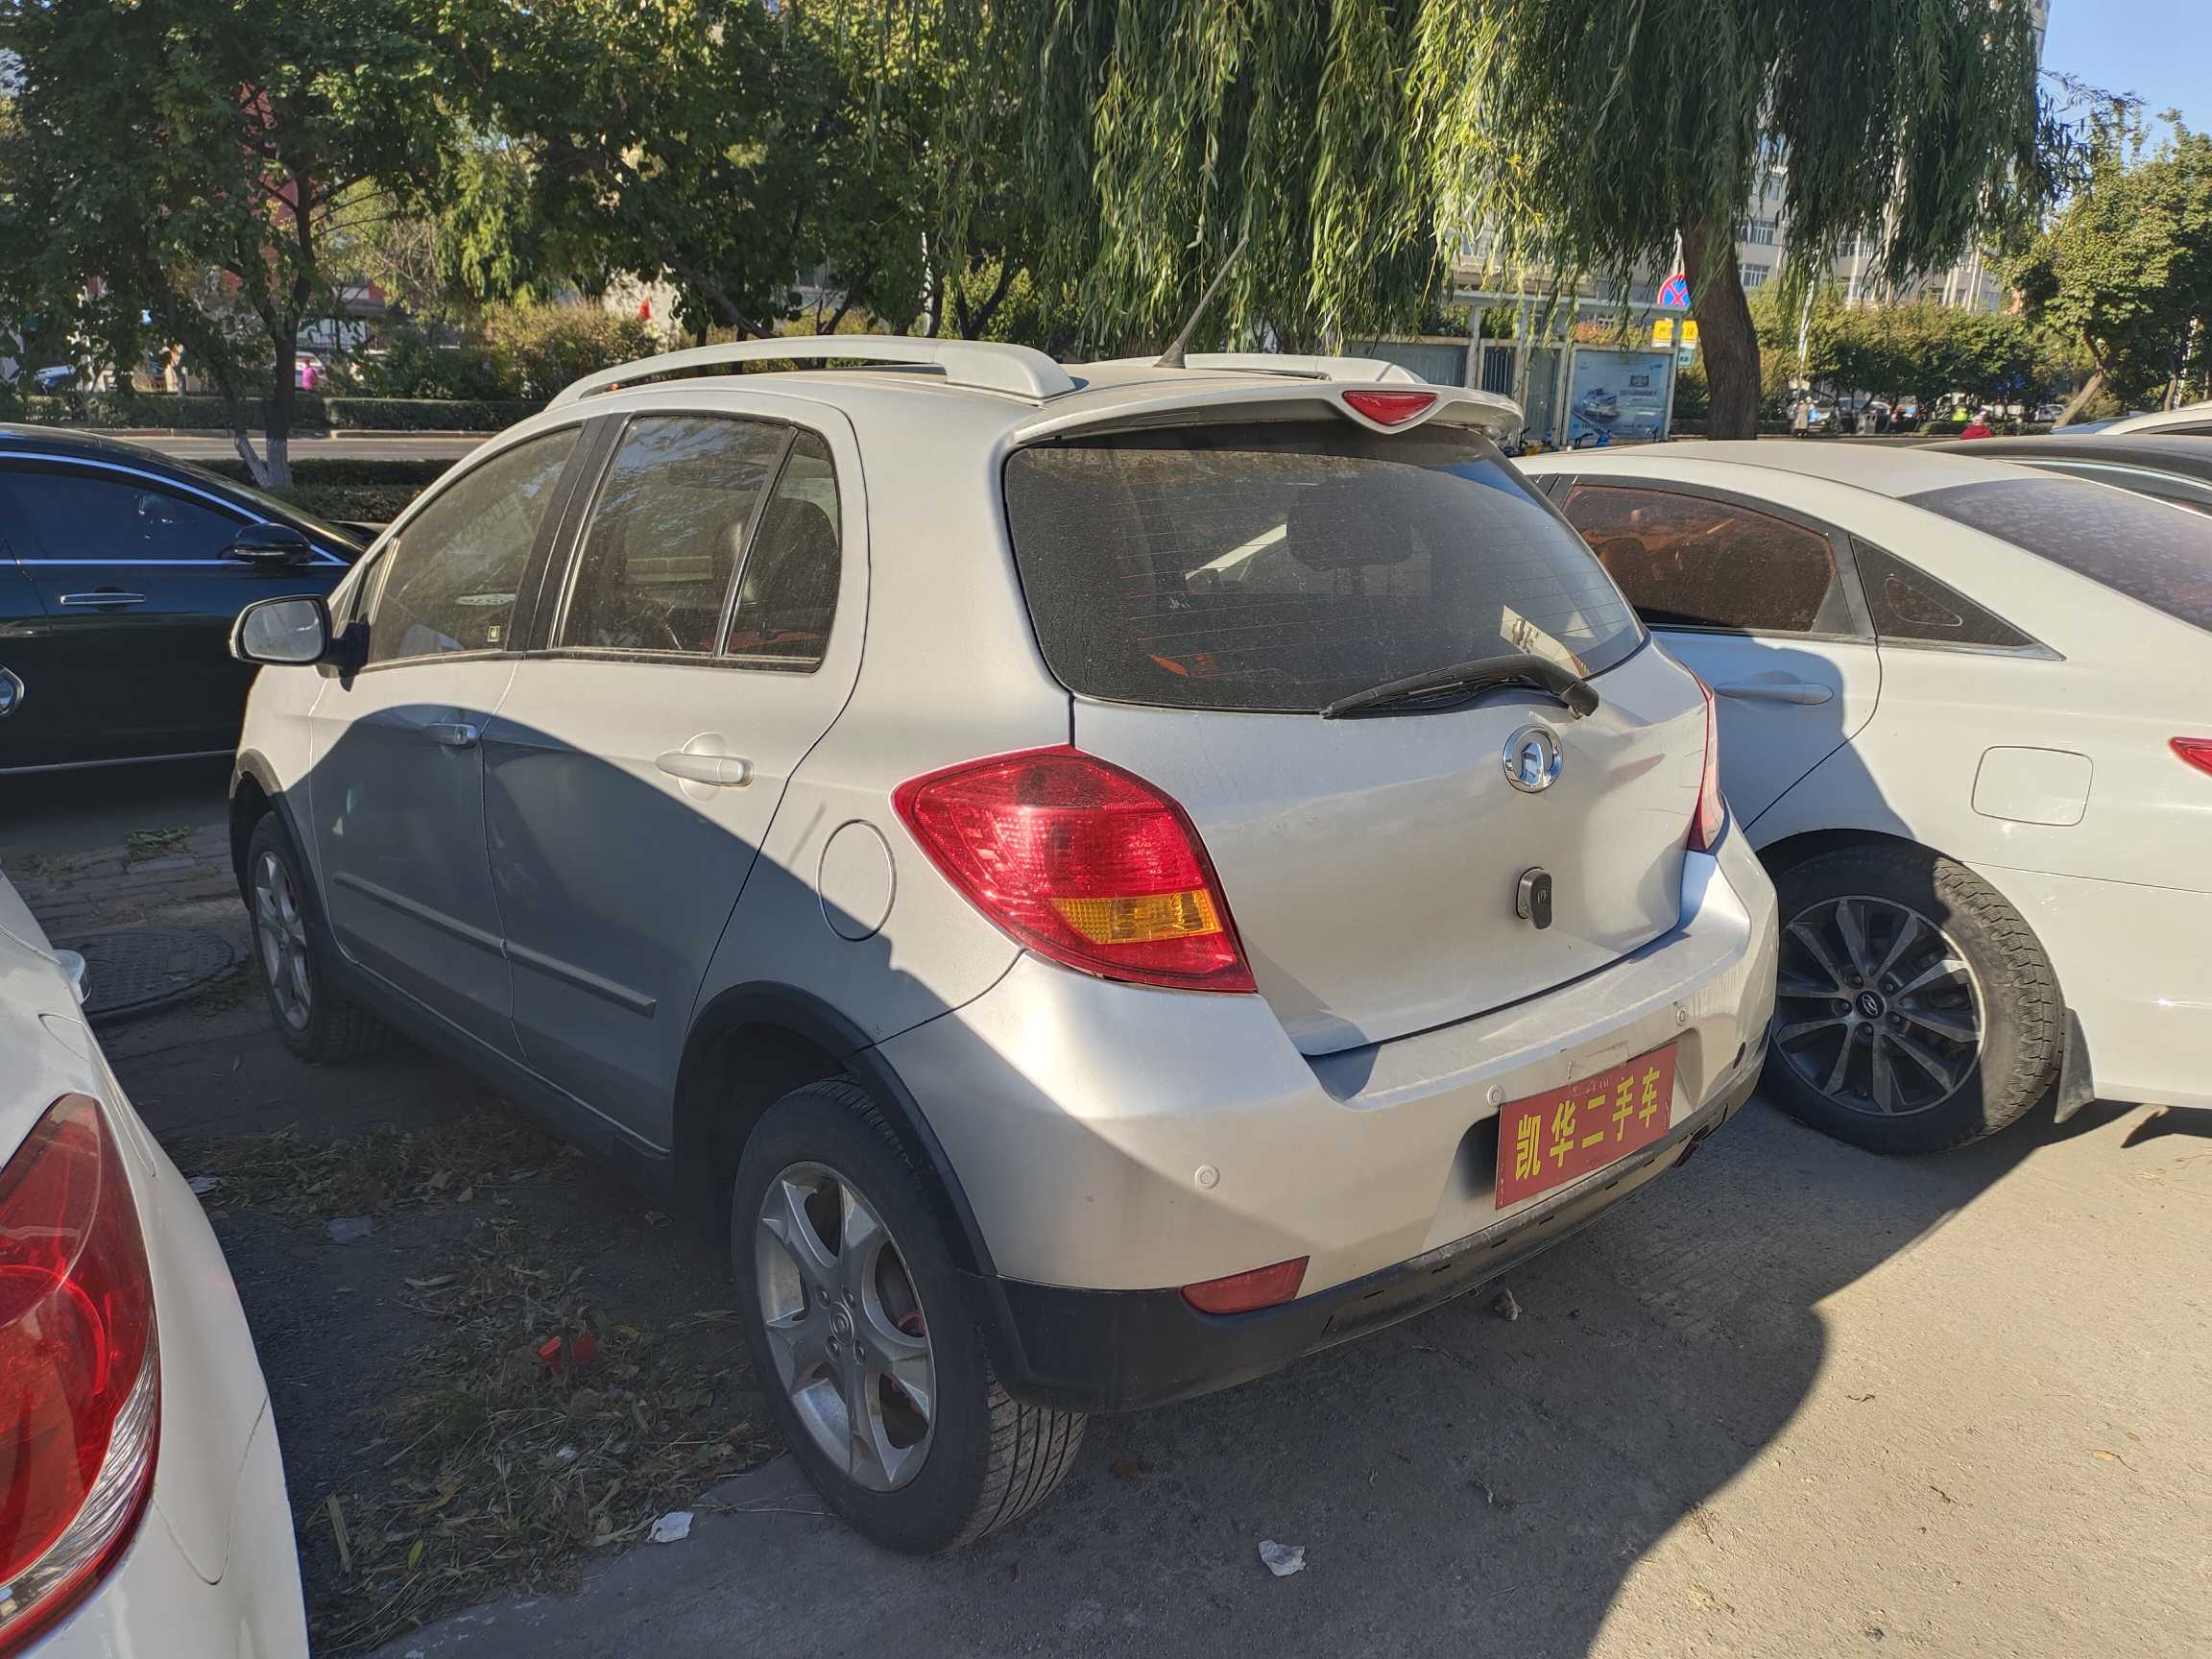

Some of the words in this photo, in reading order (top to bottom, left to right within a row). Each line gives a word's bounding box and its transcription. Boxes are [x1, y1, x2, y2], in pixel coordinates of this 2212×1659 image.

[1515, 1068, 1660, 1181] 凯华二手车
